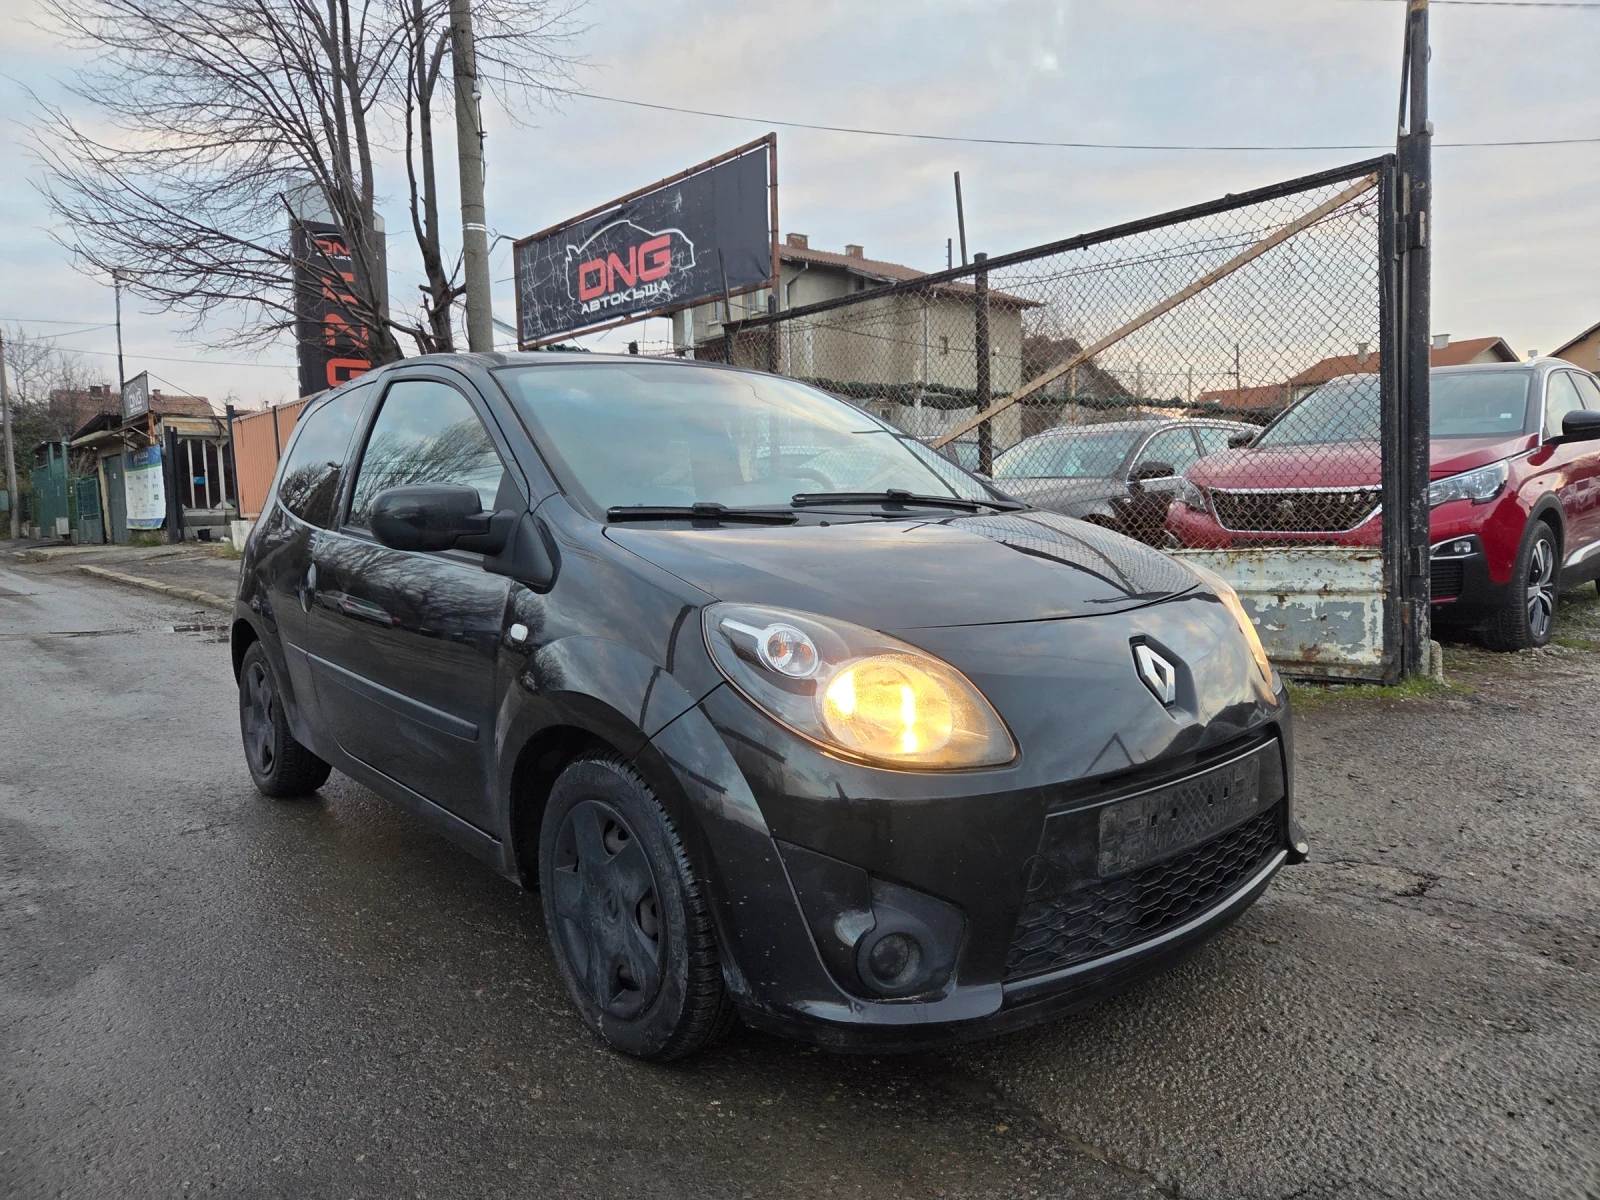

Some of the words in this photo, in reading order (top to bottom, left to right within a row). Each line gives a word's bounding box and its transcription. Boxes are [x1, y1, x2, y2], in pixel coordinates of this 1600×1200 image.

[314, 239, 351, 255] DN
[579, 235, 670, 300] DNG
[129, 391, 141, 408] DNG
